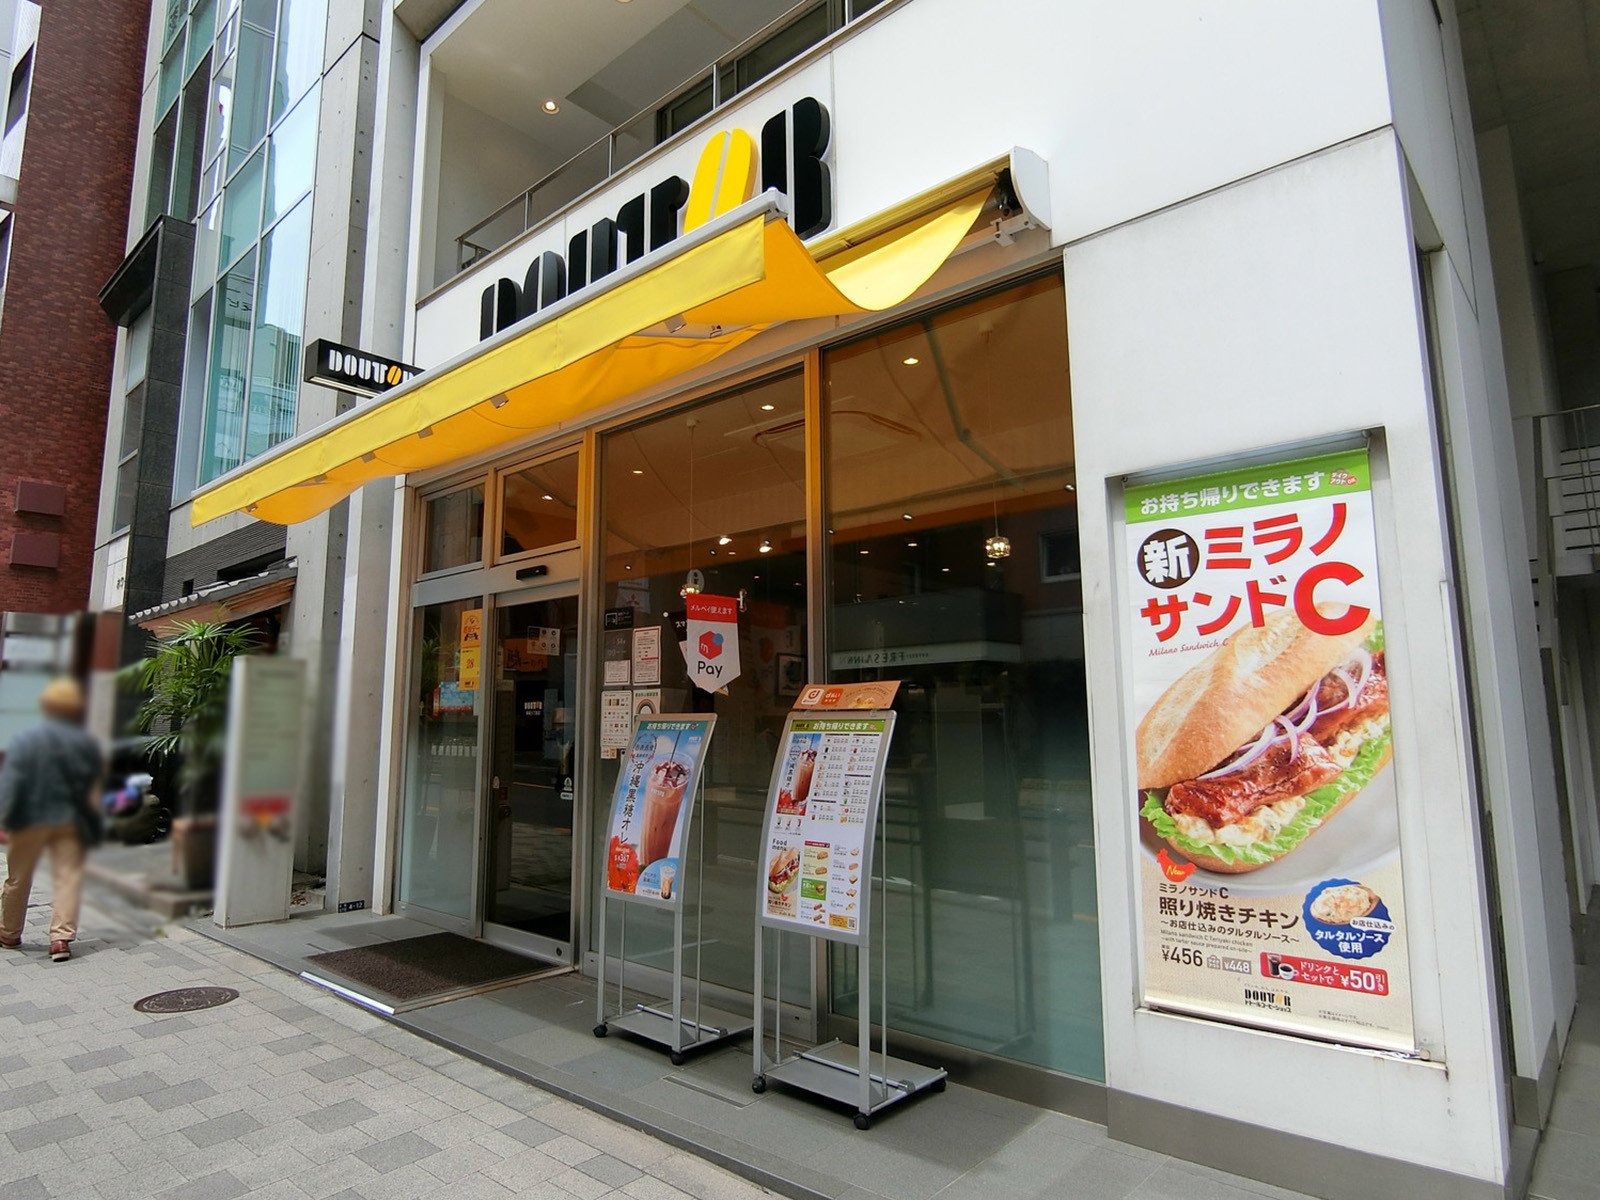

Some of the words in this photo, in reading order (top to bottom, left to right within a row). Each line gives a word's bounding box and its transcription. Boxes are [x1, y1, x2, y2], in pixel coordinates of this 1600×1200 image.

[1140, 471, 1325, 515] お持ち帰りできます
[1143, 534, 1193, 584] 新
[1205, 502, 1347, 569] ミラノ
[1140, 561, 1371, 643] サンドC
[1148, 645, 1178, 657] Milano
[1179, 639, 1219, 652] Sandwich
[697, 660, 723, 678] Pay
[812, 721, 869, 731] お持ち帰りできます
[1159, 882, 1229, 899] ミラノサンドC
[1159, 896, 1299, 929] 照り焼きチキン
[1352, 919, 1395, 931] お店仕込みの
[1314, 929, 1385, 943] タルタルソース
[1338, 941, 1363, 954] 使用
[1162, 946, 1203, 967] ¥456
[1224, 960, 1250, 973] ¥448
[1300, 961, 1340, 976] ドリンクと
[1301, 971, 1335, 985] セットで
[1244, 988, 1292, 1006] DOUTOR
